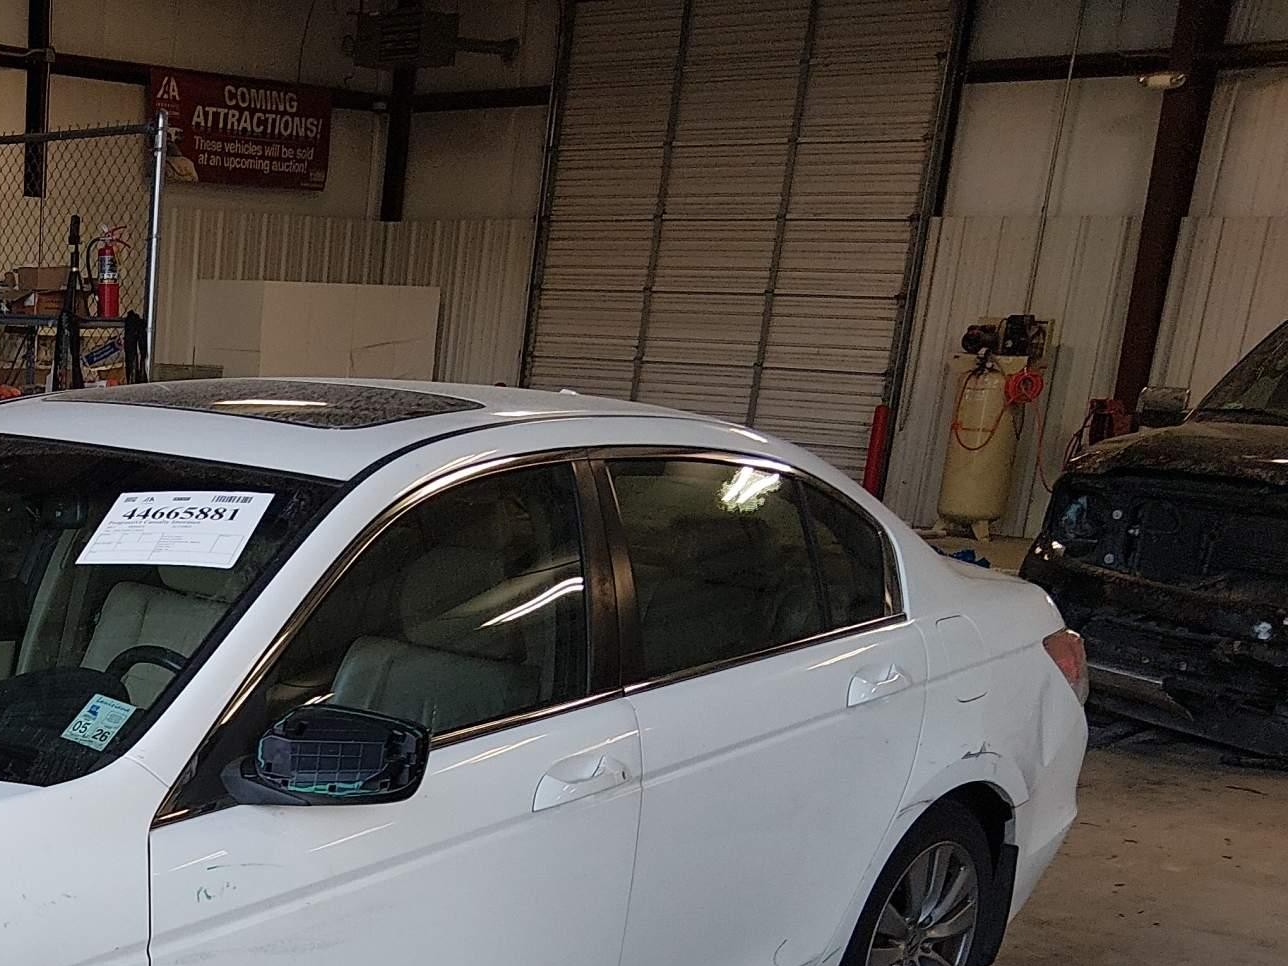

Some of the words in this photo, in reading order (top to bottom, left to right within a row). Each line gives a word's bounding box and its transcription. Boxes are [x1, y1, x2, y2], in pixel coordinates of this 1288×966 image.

[224, 85, 298, 112] COMING
[191, 105, 323, 138] ATTRACTIONS!
[194, 136, 223, 152] These
[224, 138, 263, 156] vehicles
[264, 143, 280, 157] will
[281, 145, 294, 158] be
[296, 147, 314, 160] sold
[198, 153, 207, 165] at
[209, 155, 221, 166] an
[223, 156, 270, 174] upcoming
[271, 159, 308, 174] auction!
[122, 506, 240, 521] 44665881
[72, 720, 92, 734] 05
[91, 728, 111, 742] 26
